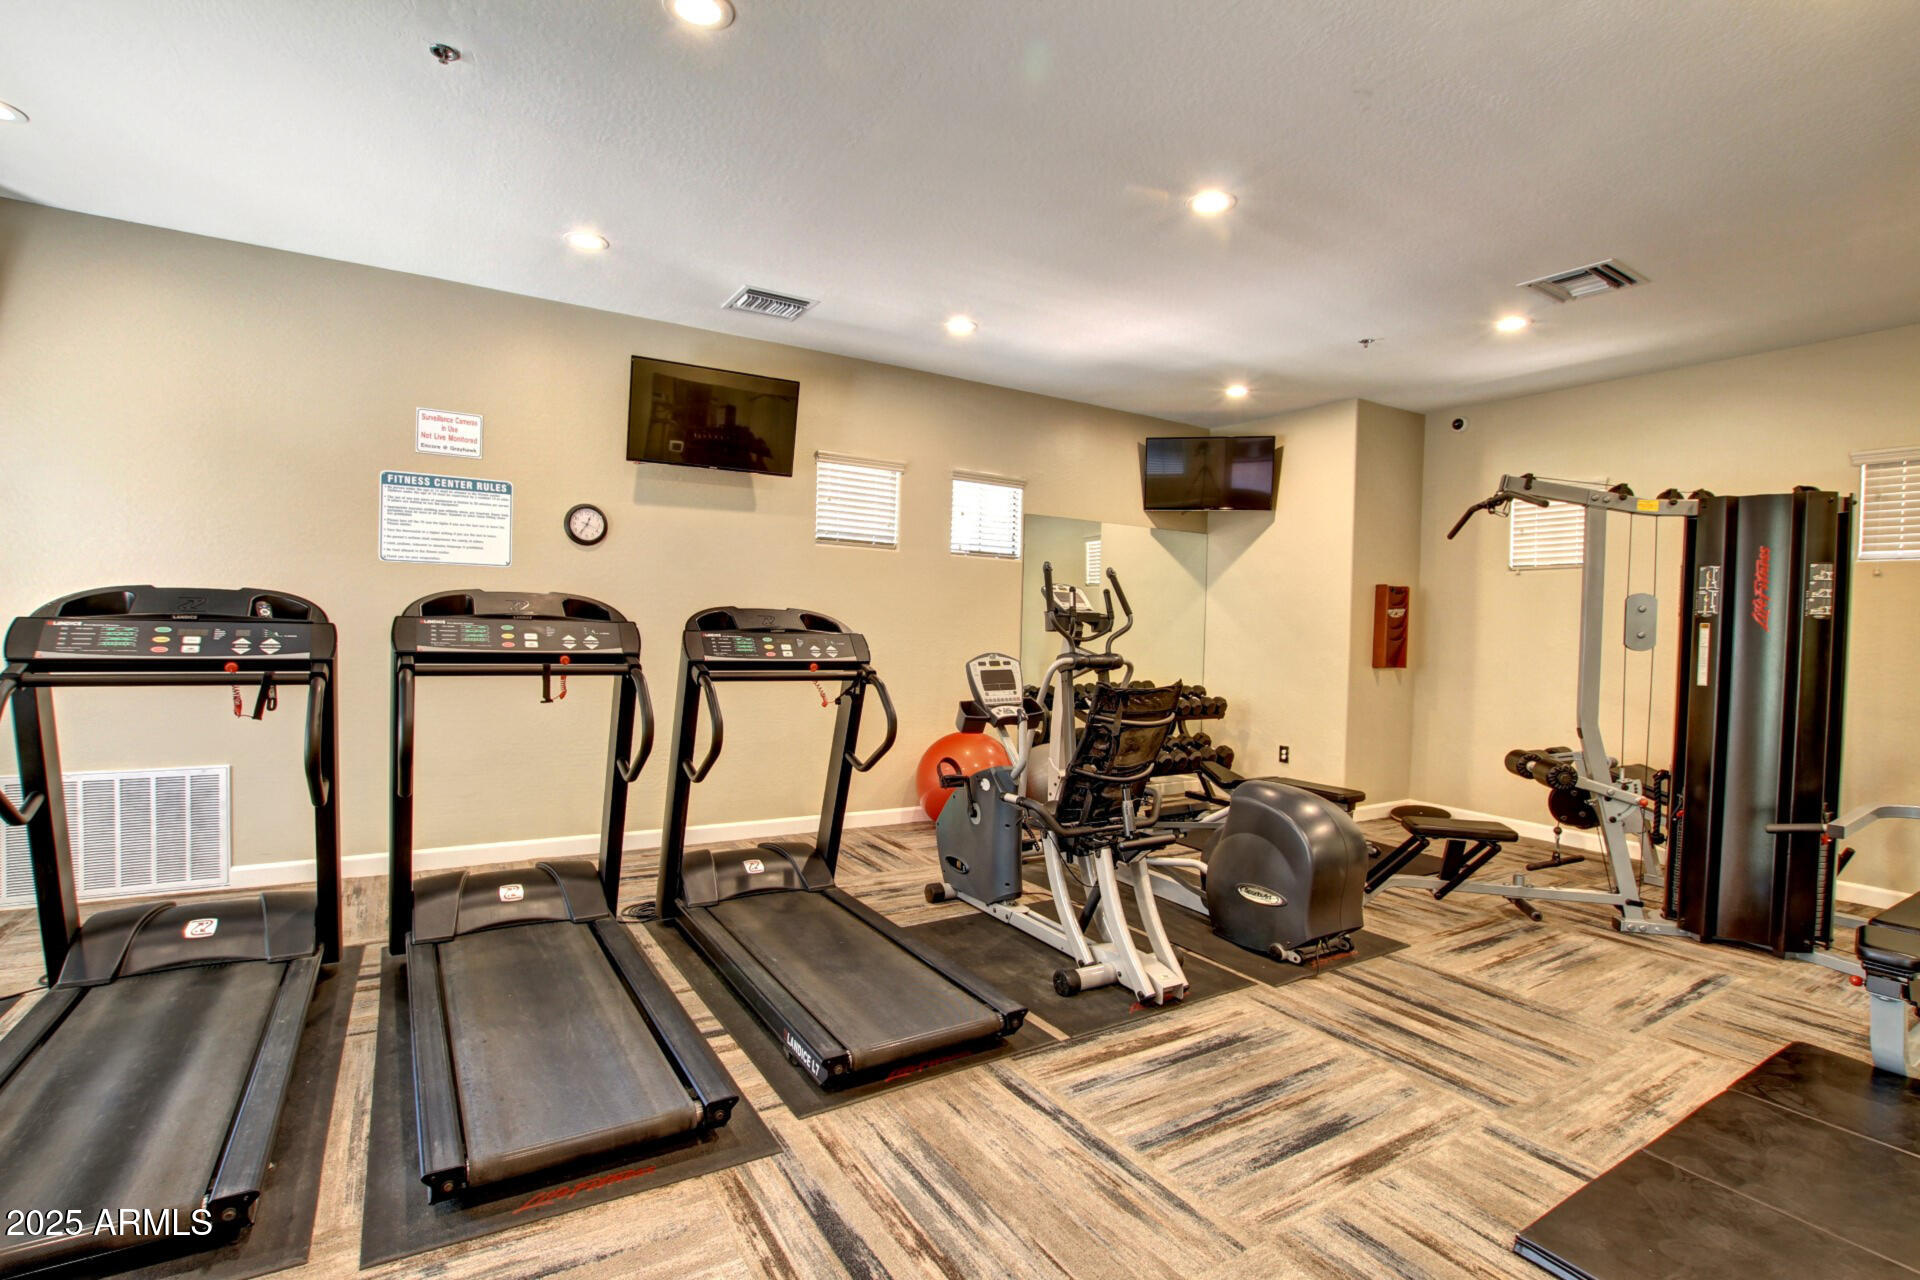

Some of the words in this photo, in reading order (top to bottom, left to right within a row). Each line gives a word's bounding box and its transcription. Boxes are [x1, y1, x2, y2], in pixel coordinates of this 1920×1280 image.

[421, 413, 454, 423] Surveillance
[455, 417, 478, 426] Cameras
[441, 424, 447, 432] in
[448, 425, 458, 433] Use
[420, 431, 432, 439] Not
[434, 433, 446, 441] Live
[448, 434, 478, 444] Monitored
[387, 474, 430, 486] FITNESS
[434, 478, 473, 490] CENTER
[476, 481, 507, 493] RULES
[786, 1032, 812, 1069] LANDICE
[811, 1059, 820, 1076] L7
